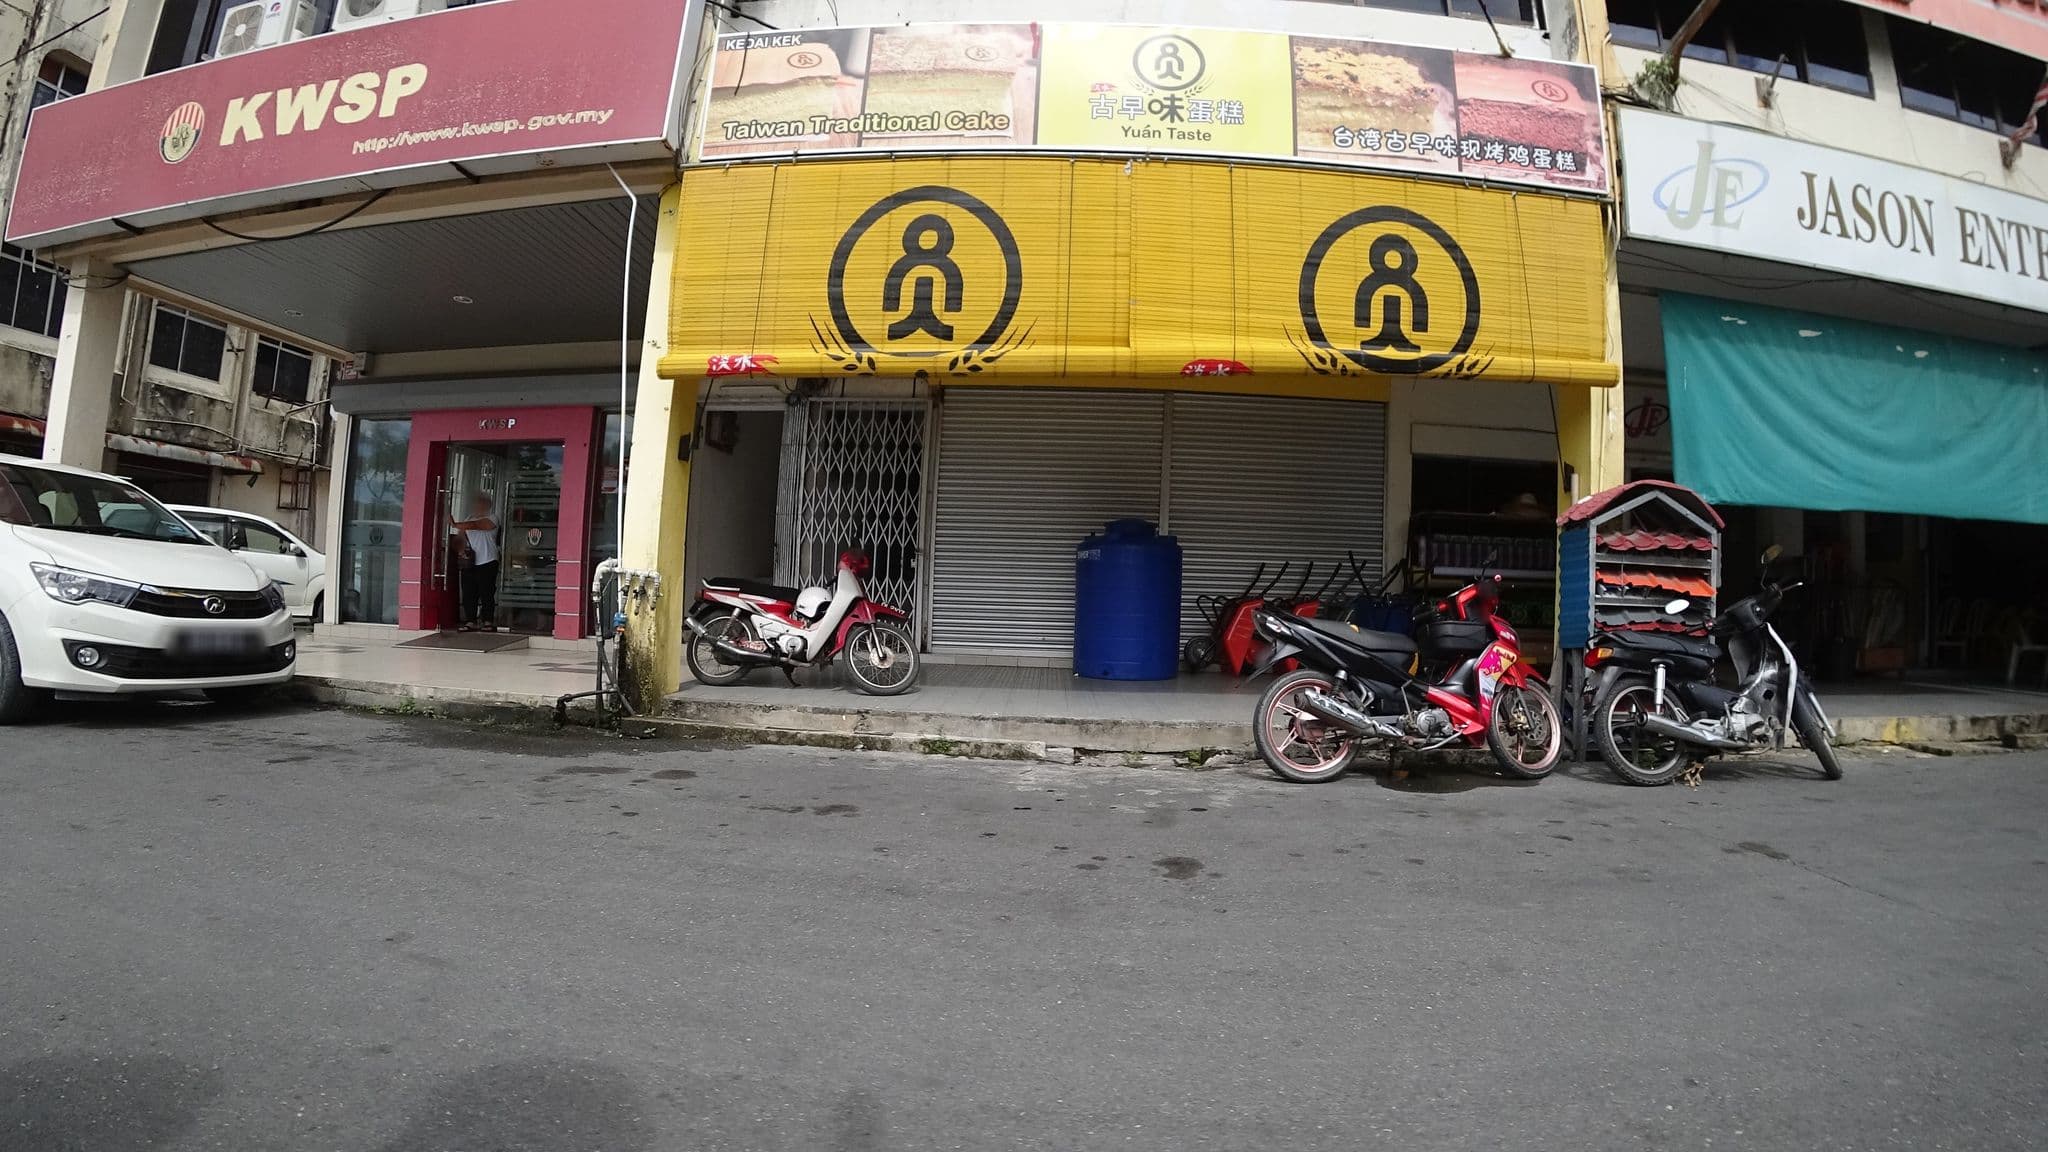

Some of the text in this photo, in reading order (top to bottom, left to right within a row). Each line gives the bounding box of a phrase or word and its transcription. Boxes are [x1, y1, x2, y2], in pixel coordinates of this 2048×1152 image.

[726, 34, 802, 50] KEDAI KEK
[219, 63, 428, 147] KWSP
[1088, 92, 1244, 125] 古早味蛋糕
[723, 109, 1010, 141] Taiwan Traditional Cake
[1120, 124, 1212, 142] Yuán Taste
[1332, 125, 1577, 172] 台湾古早味现烤鸡蛋糕
[1665, 140, 1745, 231] JE
[1797, 171, 1936, 257] JASON
[479, 418, 516, 430] KWSP
